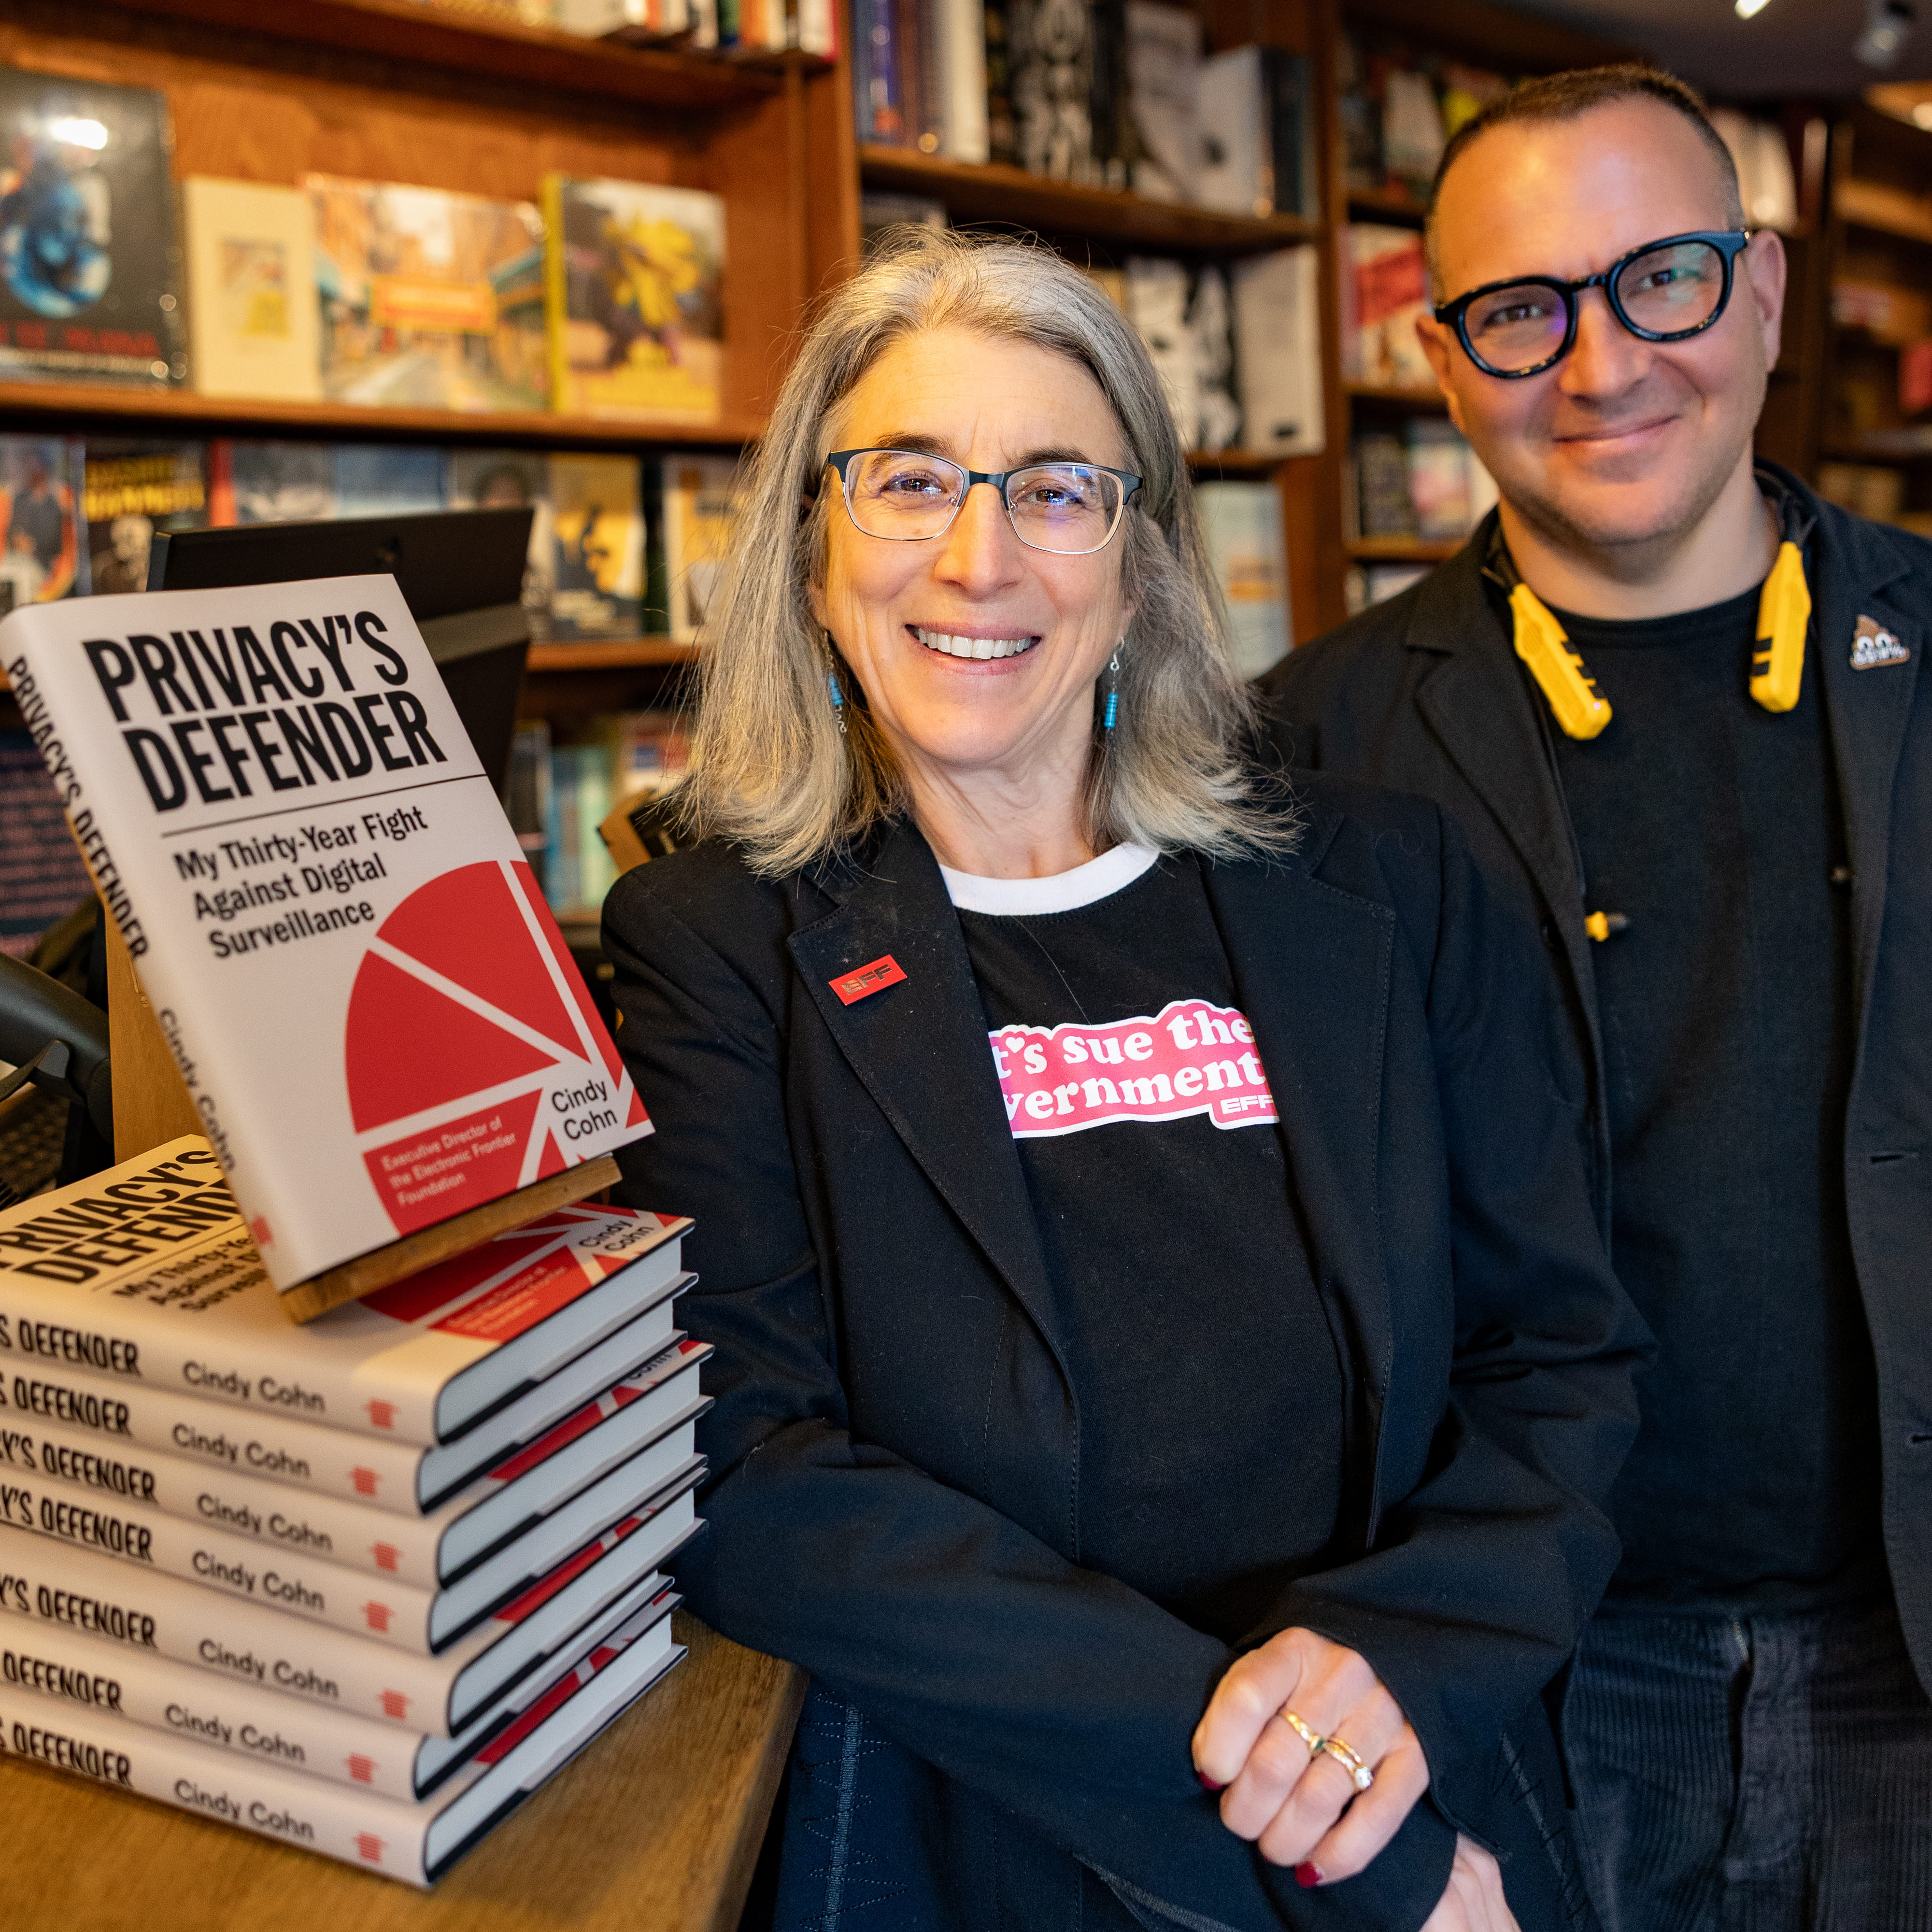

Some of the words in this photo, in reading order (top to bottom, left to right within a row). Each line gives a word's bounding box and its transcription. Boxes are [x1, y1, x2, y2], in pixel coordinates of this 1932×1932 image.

[83, 611, 409, 722] PRIVACY'S
[122, 690, 448, 812] DEFENDER
[174, 850, 219, 881] My
[220, 824, 359, 869] Thirty-Year
[361, 806, 428, 841] Fight
[74, 807, 148, 960] DEFENDER
[194, 872, 299, 921] Against
[300, 852, 387, 894] Digital
[209, 901, 376, 958] Surveillance
[840, 964, 893, 995] EFF
[1063, 1032, 1153, 1064] sue
[1166, 1009, 1255, 1051] the
[159, 1008, 197, 1088] Cindy
[197, 1094, 235, 1171] Cohn
[551, 1079, 609, 1112] Cindy
[564, 1108, 618, 1140] Cohn
[1220, 1094, 1274, 1115] EFF
[382, 1142, 441, 1171] Executive
[441, 1123, 487, 1149] Director
[489, 1115, 503, 1131] of
[389, 1173, 412, 1188] the
[412, 1150, 472, 1180] Electronic
[471, 1132, 516, 1157] Frontier
[397, 1173, 466, 1207] Foundation
[579, 1220, 633, 1248] Cindy
[605, 1226, 654, 1251] Cohn
[19, 1318, 141, 1376] DEFENDER
[183, 1360, 251, 1399] Cindy
[258, 1376, 327, 1413] Cohn
[14, 1376, 132, 1436] DEFENDER
[171, 1422, 238, 1463] Cindy
[244, 1440, 311, 1478] Cohn
[43, 1441, 158, 1504] DEFENDER
[196, 1493, 261, 1534] Cindy
[268, 1512, 333, 1550] Cohn
[41, 1496, 153, 1562] DEFENDER
[192, 1549, 256, 1592] Cindy
[262, 1570, 326, 1611] Cohn
[37, 1584, 157, 1648] DEFENDER
[198, 1638, 266, 1679] Cindy
[272, 1659, 340, 1699] Cohn
[3, 1649, 124, 1712] DEFENDER
[164, 1703, 232, 1742] Cindy
[240, 1724, 306, 1763] Cohn
[13, 1720, 133, 1787] DEFENDER
[174, 1779, 241, 1820] Cindy
[248, 1801, 315, 1839] Cohn
